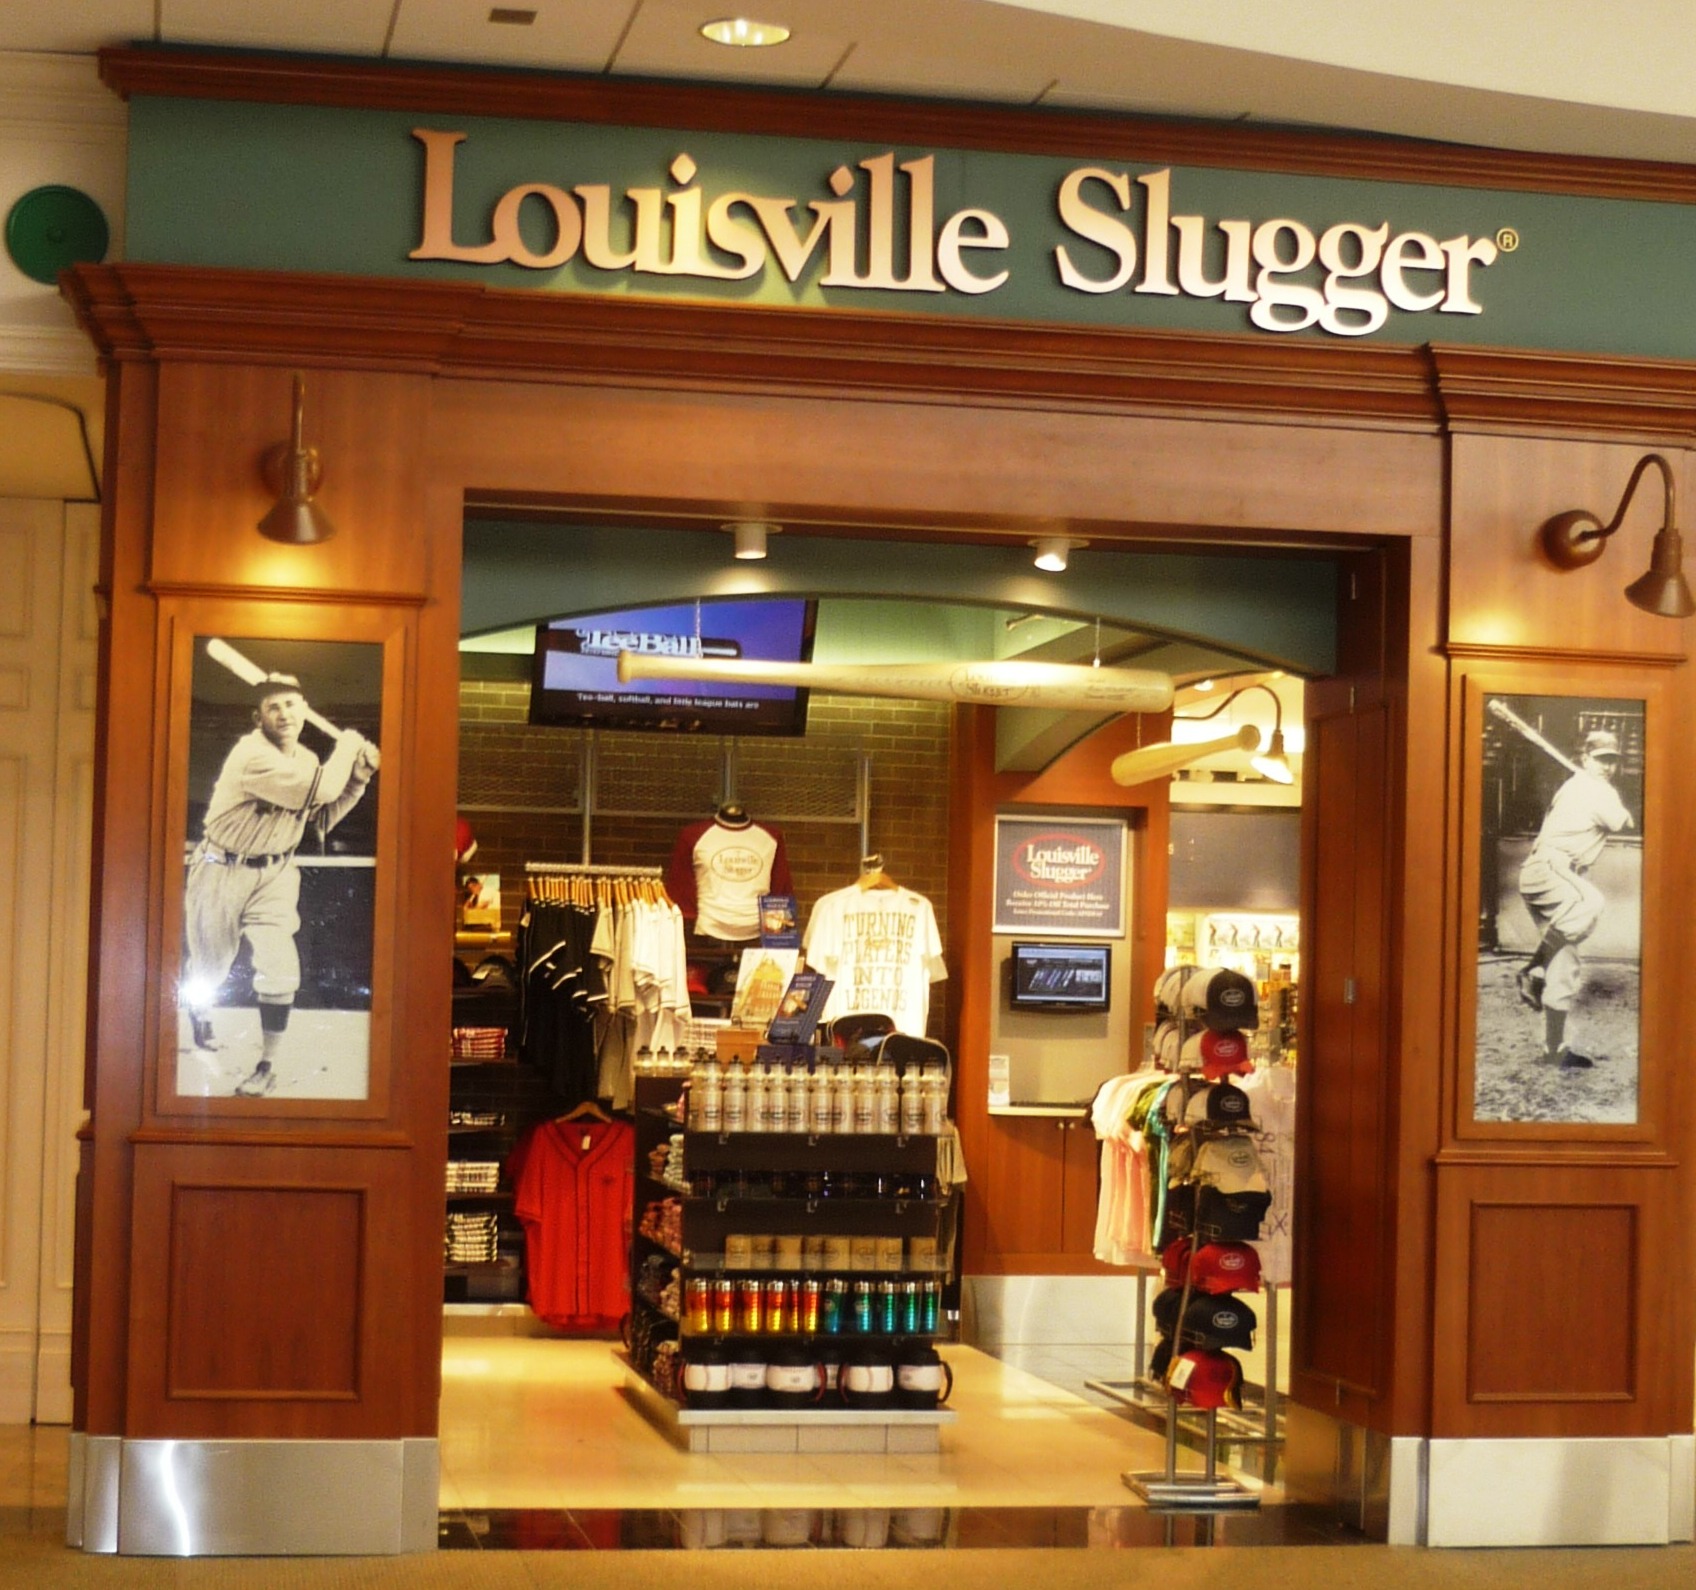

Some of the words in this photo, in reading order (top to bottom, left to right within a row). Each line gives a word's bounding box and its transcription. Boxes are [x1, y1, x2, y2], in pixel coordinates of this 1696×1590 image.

[407, 127, 1010, 295] Louisville
[655, 695, 672, 705] and
[694, 696, 722, 709] league
[1026, 844, 1099, 866] Louisville
[1030, 861, 1089, 884] Slugger
[843, 911, 916, 939] TURNING
[853, 966, 904, 987] INTO
